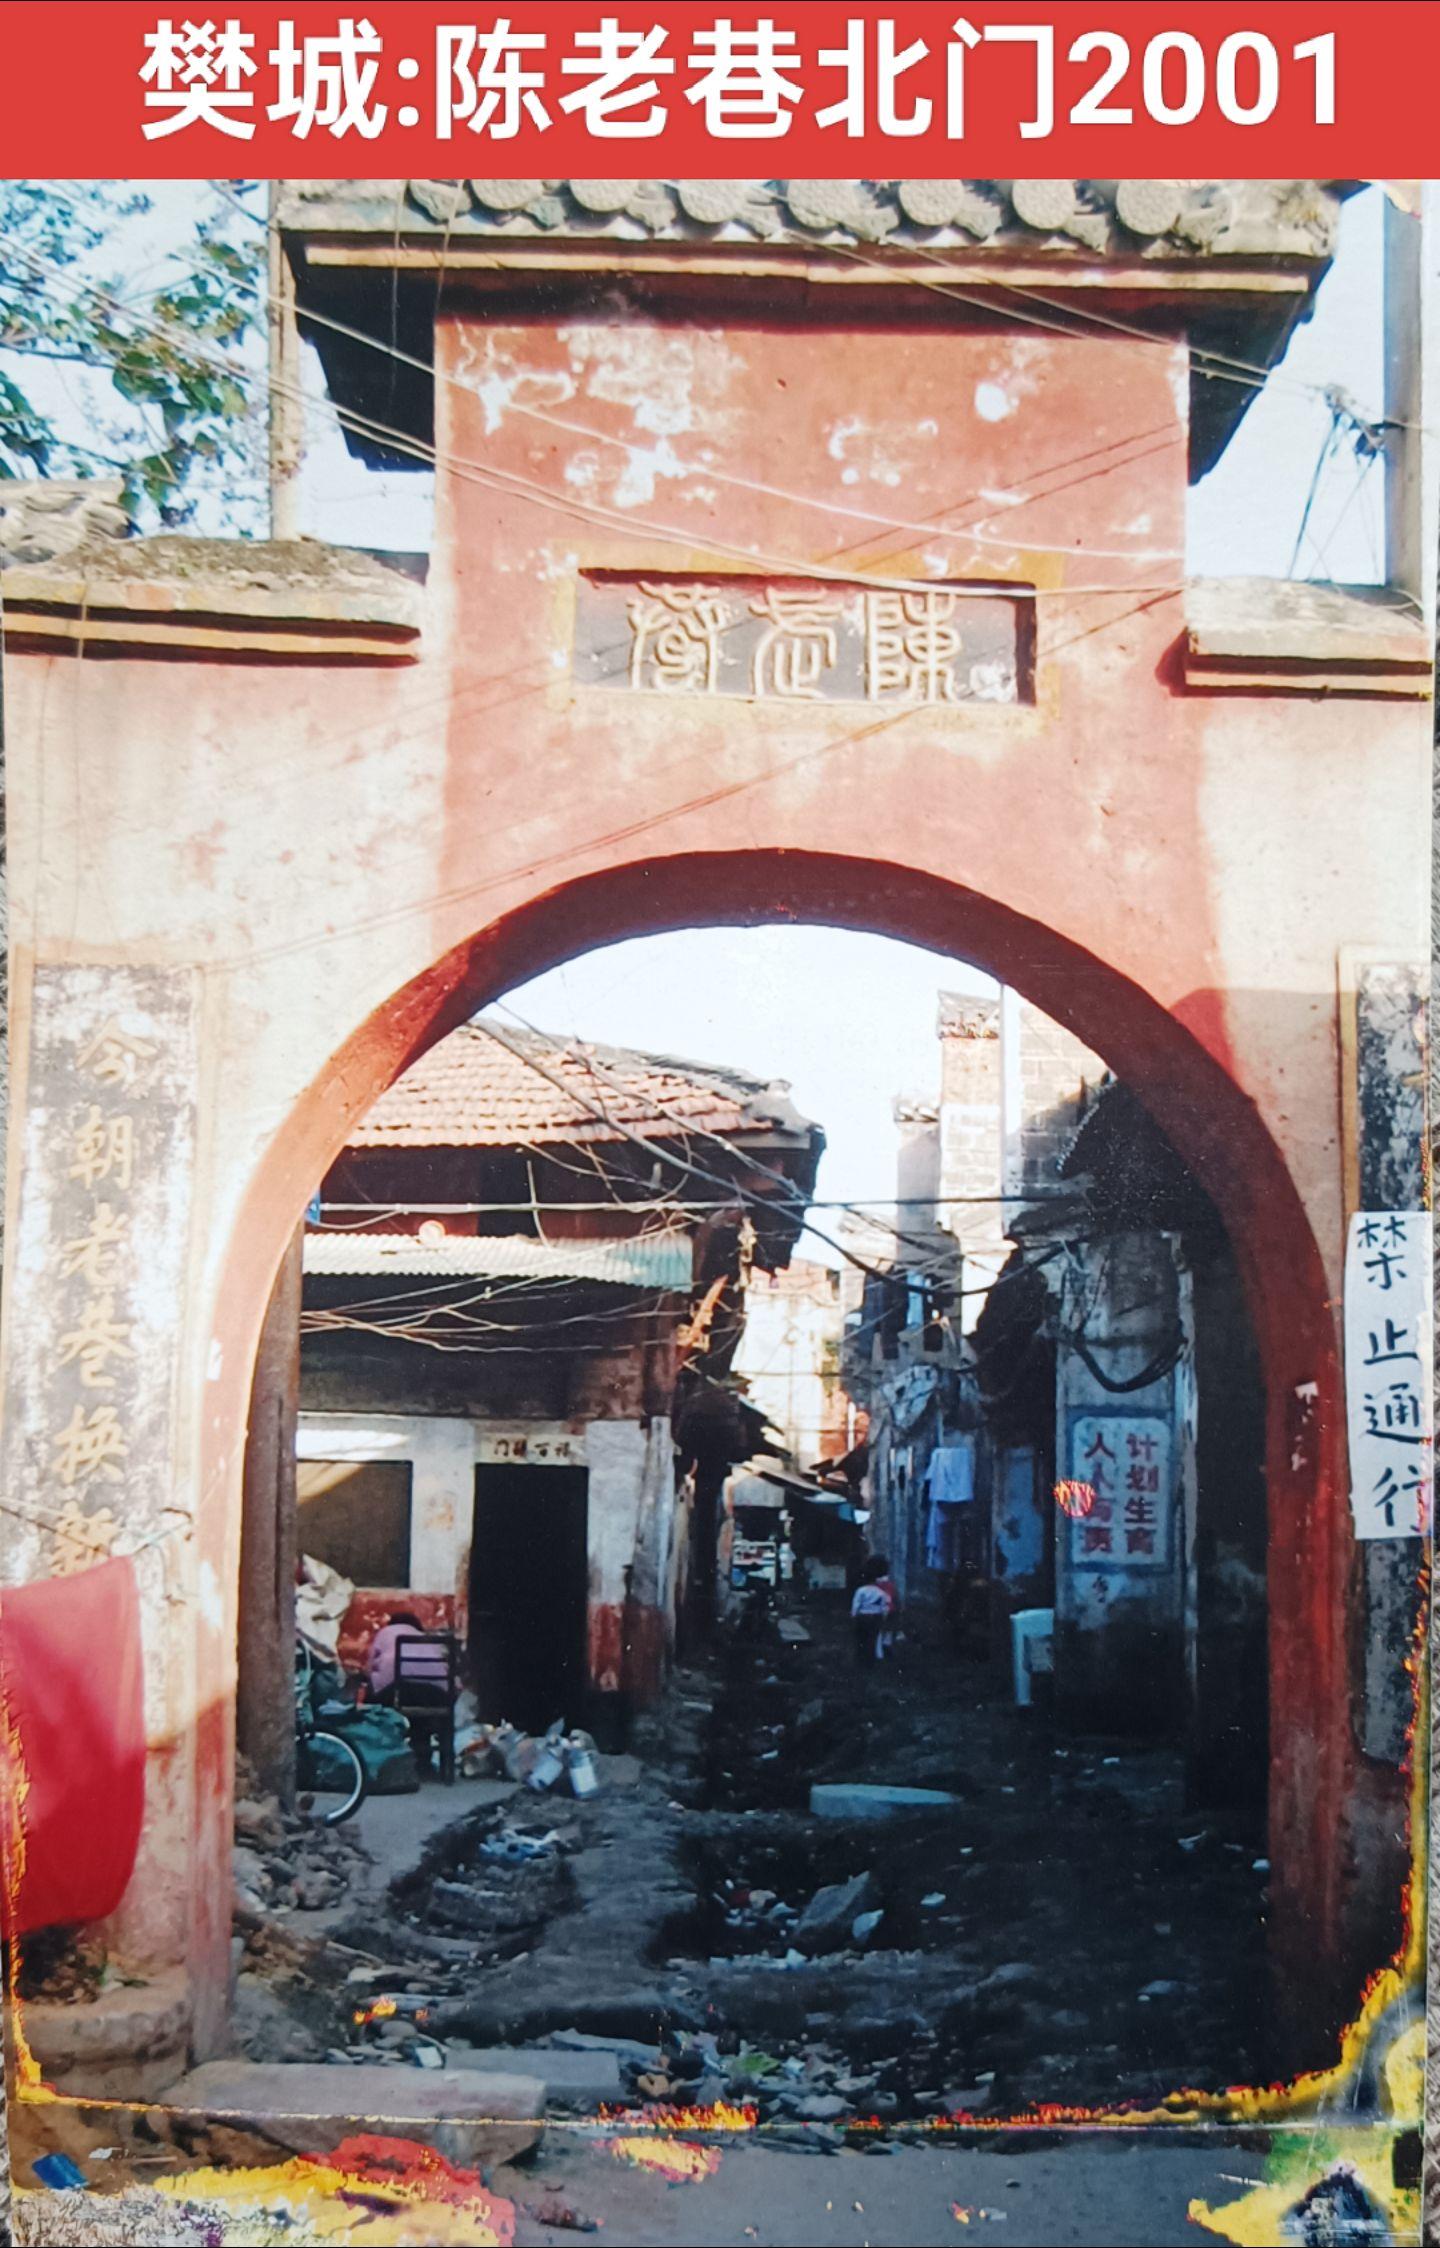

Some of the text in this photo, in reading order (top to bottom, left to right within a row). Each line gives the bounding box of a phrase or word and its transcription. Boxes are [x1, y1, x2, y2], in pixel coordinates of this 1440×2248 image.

[1357, 1216, 1426, 1533] 禁止通行
[1124, 1432, 1160, 1554] 计划生育
